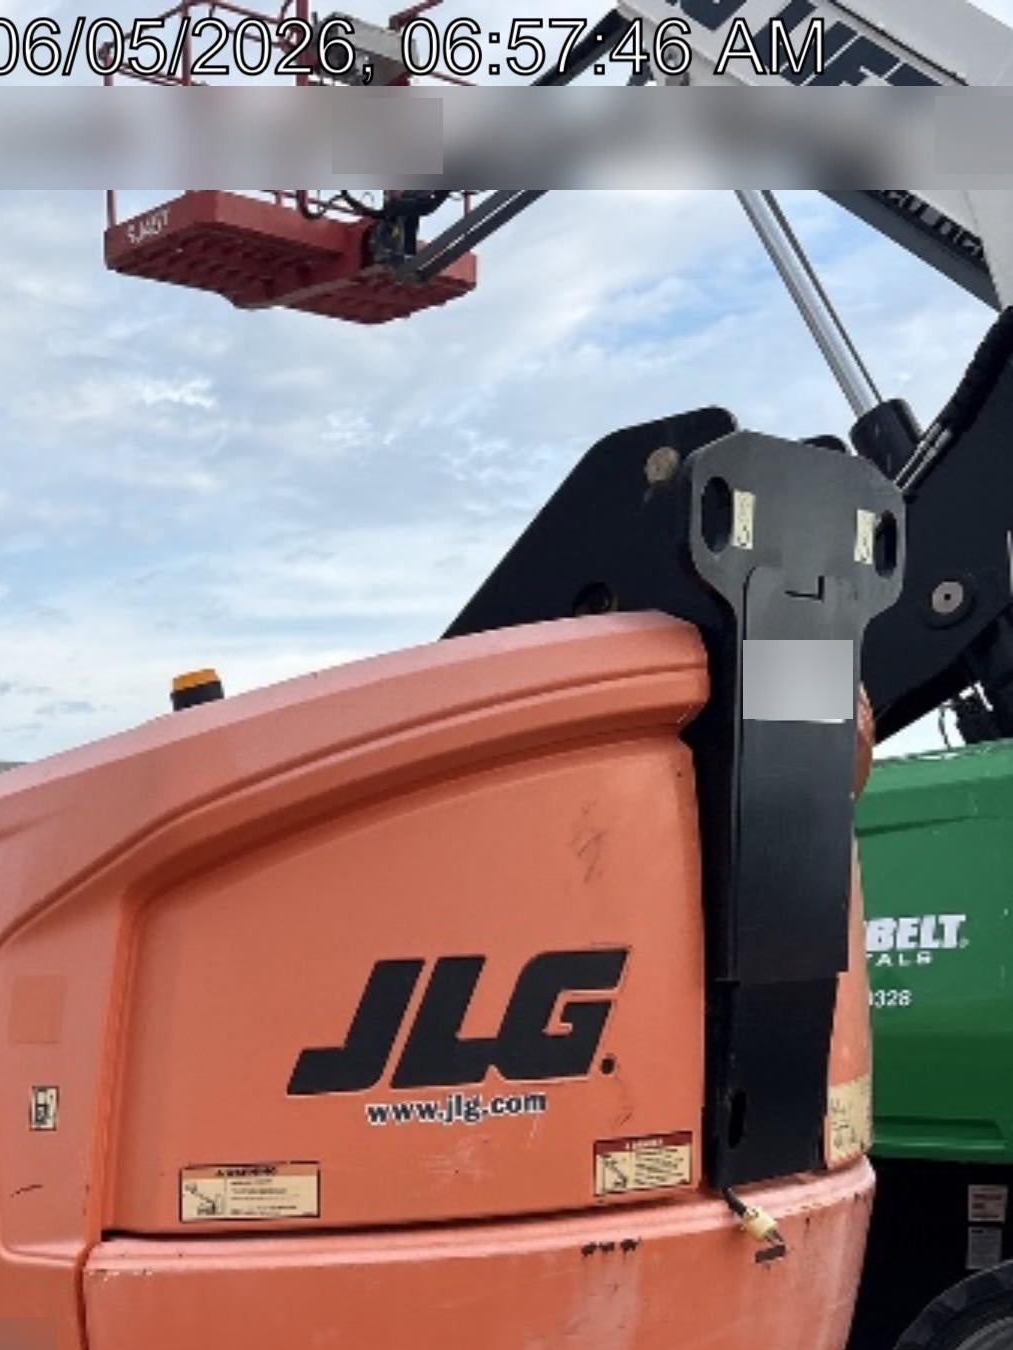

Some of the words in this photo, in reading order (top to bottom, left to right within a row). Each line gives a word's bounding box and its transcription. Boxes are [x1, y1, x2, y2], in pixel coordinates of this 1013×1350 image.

[863, 913, 967, 952] BELT
[286, 946, 630, 1096] JLG
[365, 1090, 549, 1128] www.jlg.com
